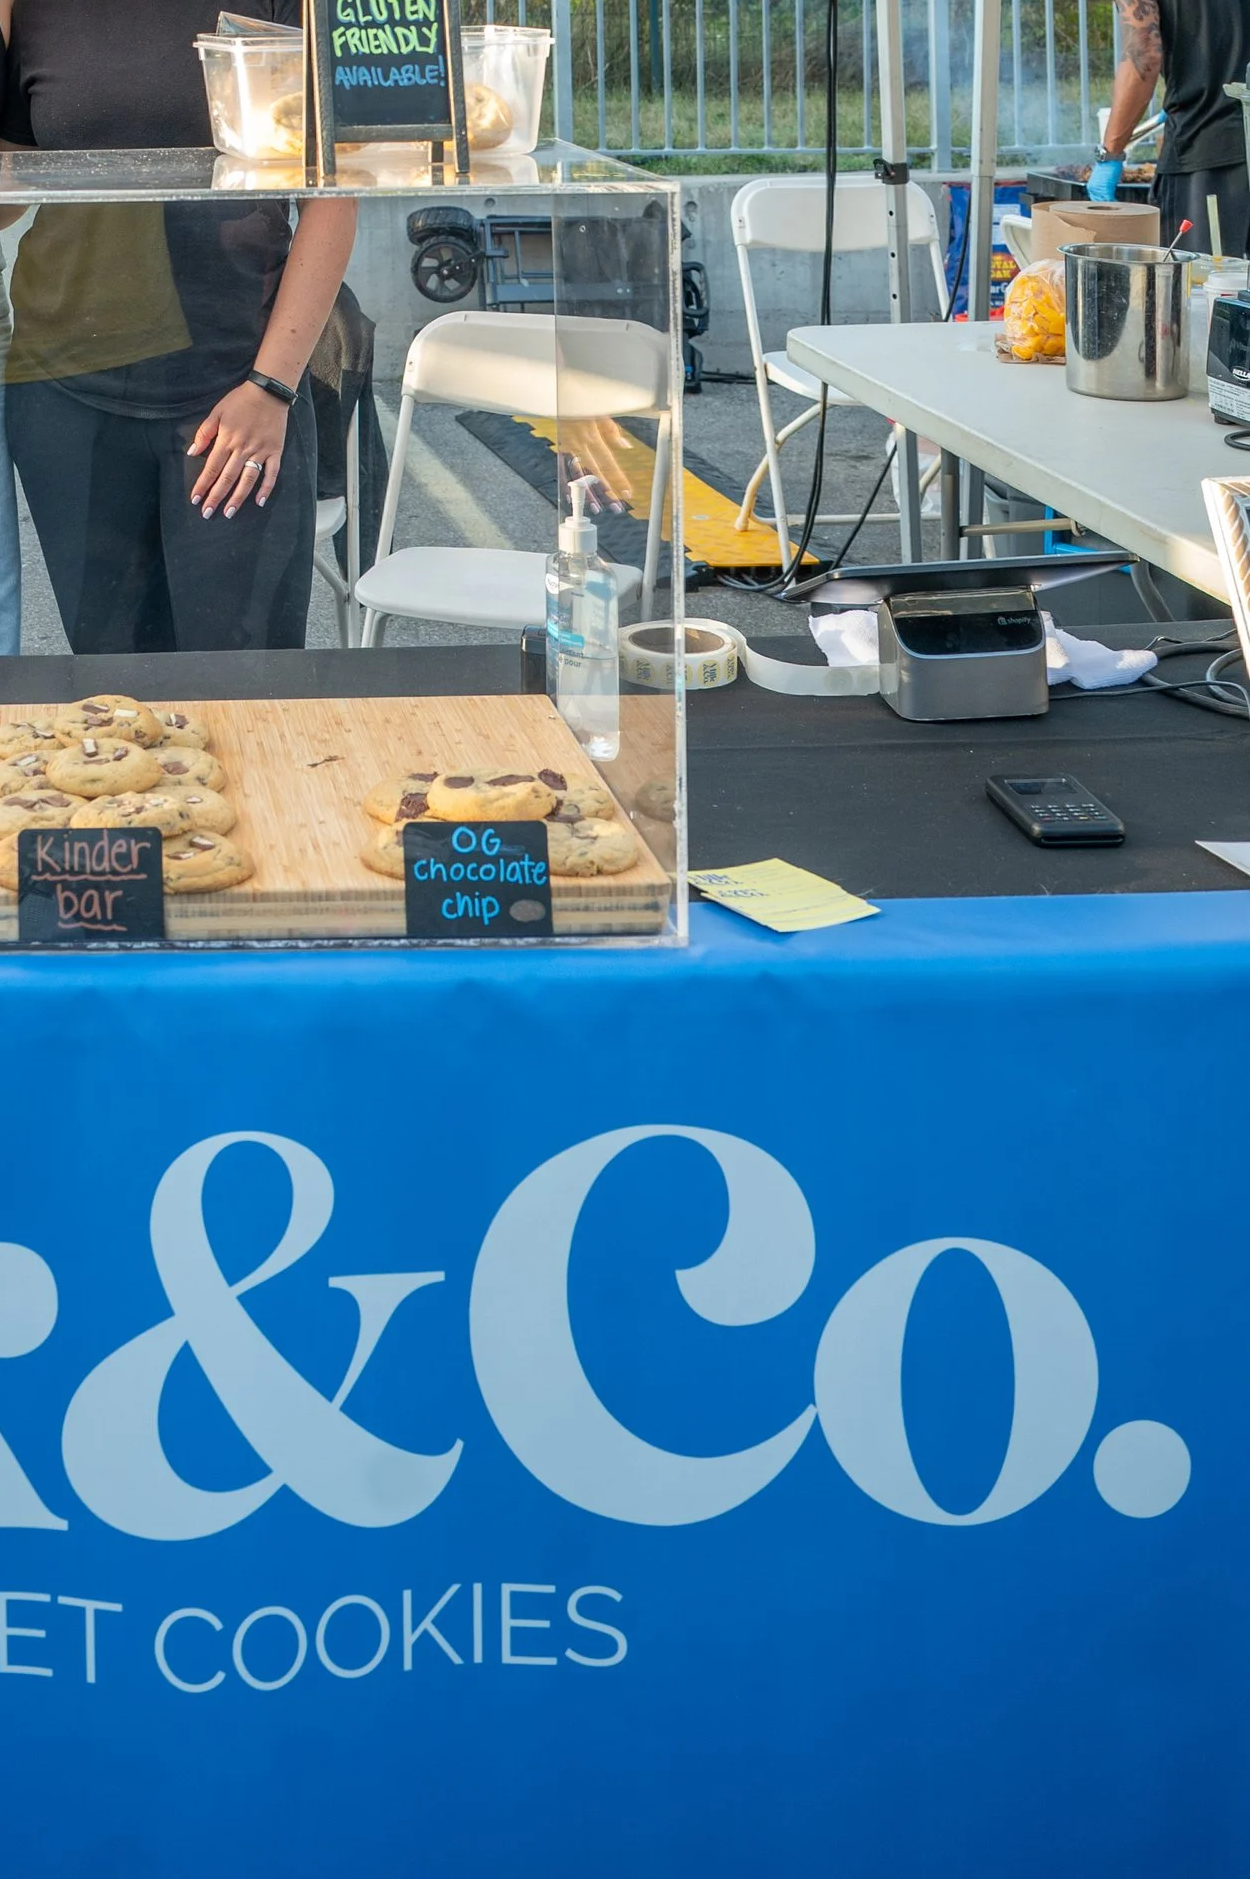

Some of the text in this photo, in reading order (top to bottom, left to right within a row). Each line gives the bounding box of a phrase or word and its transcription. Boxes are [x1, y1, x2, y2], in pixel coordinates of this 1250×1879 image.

[332, 23, 438, 57] FRIENDLY
[335, 55, 446, 90] AVAILABLE!
[36, 829, 151, 874] Kinder
[452, 826, 501, 856] OG
[413, 853, 547, 885] chocolate
[56, 883, 123, 920] bar
[441, 891, 500, 925] chip
[153, 1582, 628, 1693] COOKIES
